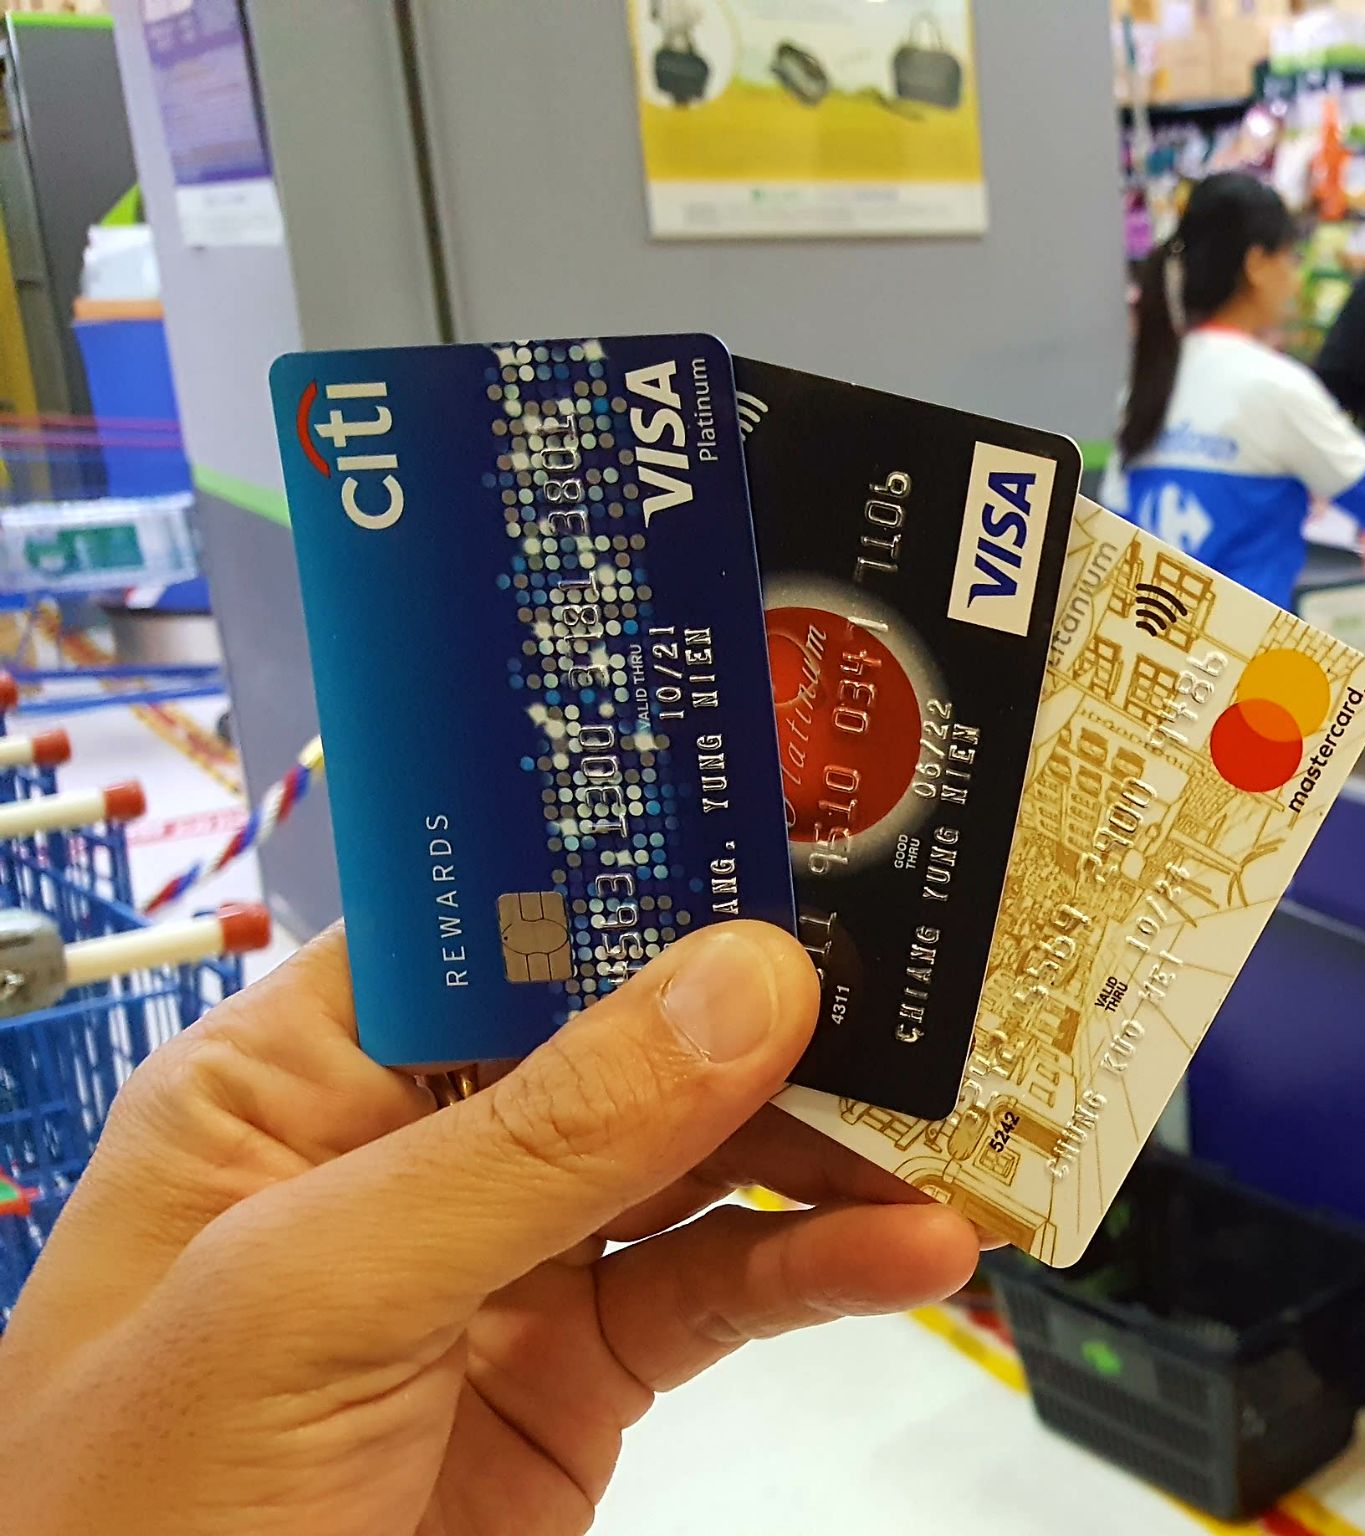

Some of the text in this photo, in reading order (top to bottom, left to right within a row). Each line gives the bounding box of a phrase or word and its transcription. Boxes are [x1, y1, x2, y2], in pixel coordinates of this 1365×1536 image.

[624, 360, 692, 528] VISA
[692, 358, 718, 461] Platinum
[539, 415, 588, 536] 3801
[967, 472, 1035, 608] VISA
[630, 644, 651, 731] VALID THRU
[651, 625, 683, 720] 10/21
[781, 625, 827, 825] latinum
[809, 766, 858, 875] 9510
[857, 471, 909, 580] 7106
[578, 723, 628, 838] 1300
[687, 626, 738, 914] ANG. YUNG NIEN
[913, 699, 953, 798] 06/22
[1079, 776, 1157, 883] 2900
[1150, 649, 1229, 755] 9486
[426, 813, 468, 987] REWARDS
[893, 833, 911, 869] GOOD
[895, 723, 980, 1043] CHIANG YUNG NIEN
[904, 837, 921, 870] THRU
[594, 873, 642, 982] 4563
[828, 984, 851, 1024] 4311
[1095, 974, 1120, 1010] VALID
[1104, 980, 1128, 1014] THRU
[989, 1110, 1021, 1154] 5242
[1046, 1089, 1106, 1180] CHUNG
